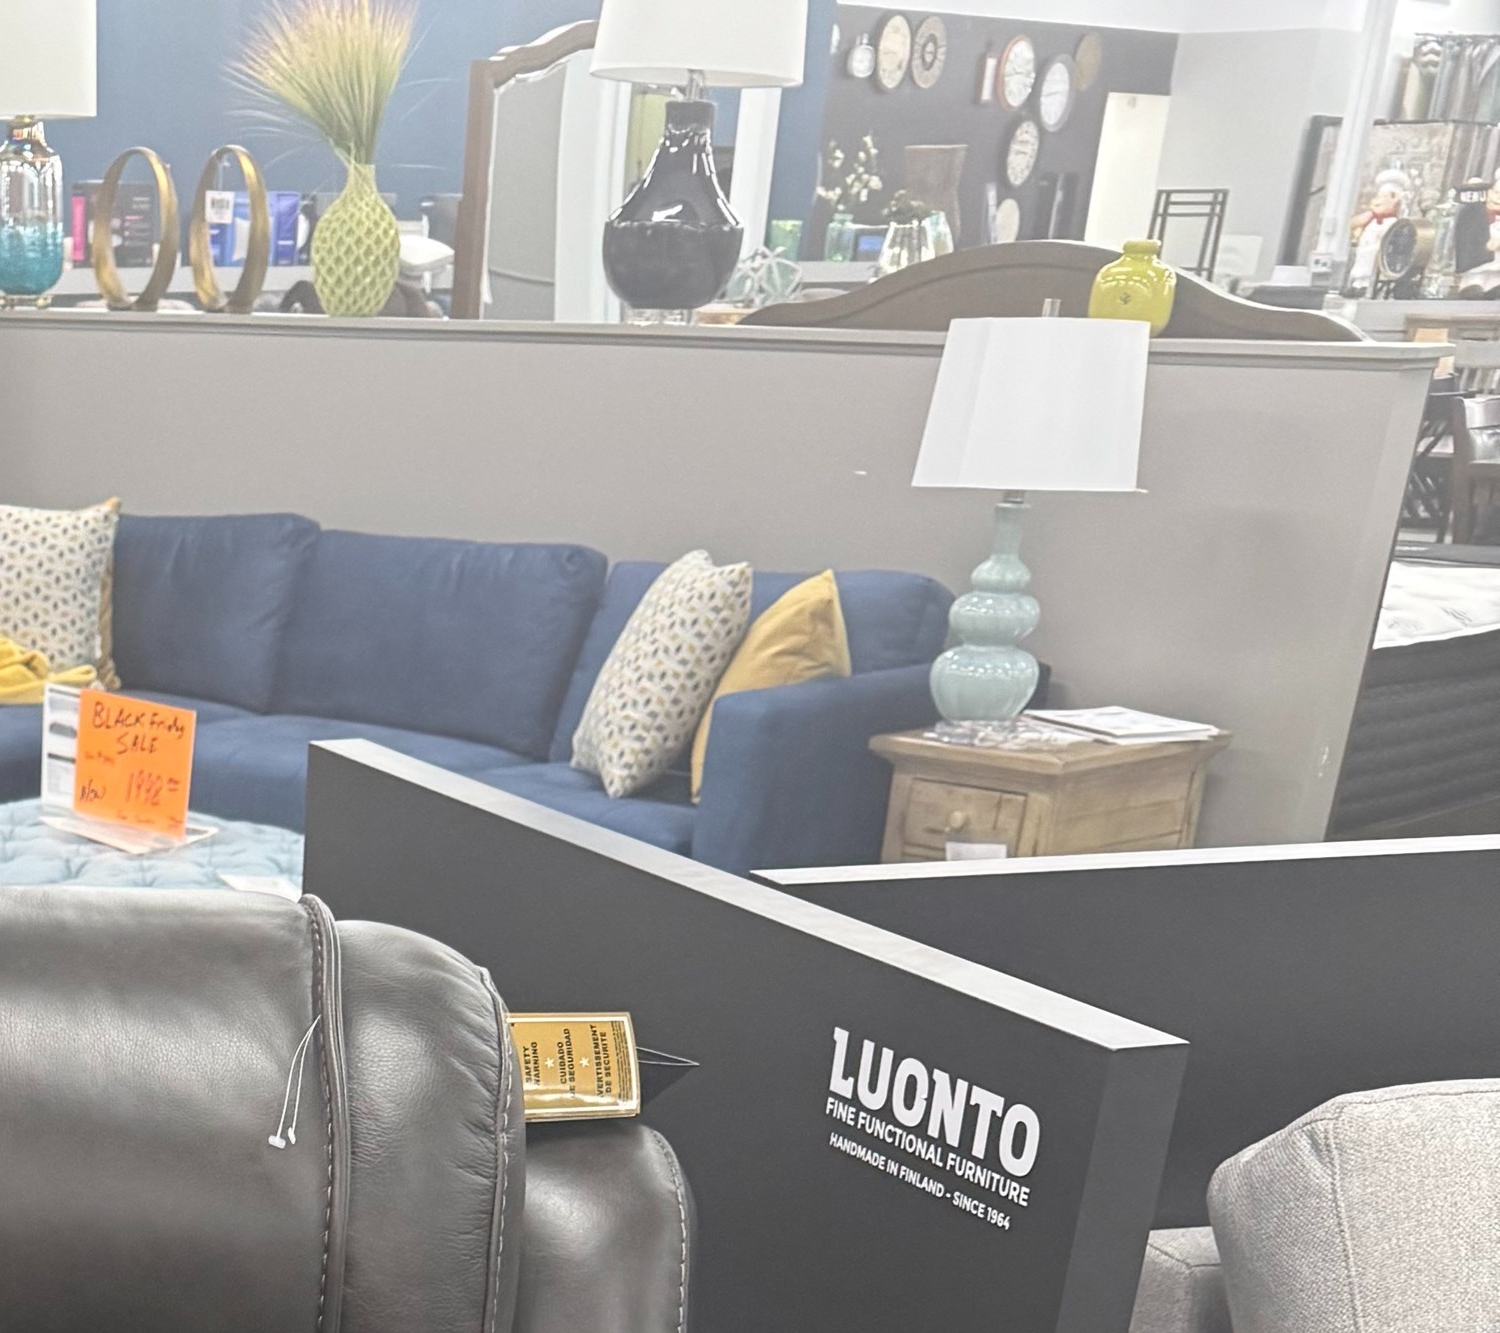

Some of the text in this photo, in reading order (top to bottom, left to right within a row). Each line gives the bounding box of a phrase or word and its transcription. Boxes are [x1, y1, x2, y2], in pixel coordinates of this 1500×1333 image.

[92, 701, 146, 730] BLACK
[116, 732, 159, 755] SALE
[523, 1046, 531, 1083] SAFETY
[557, 1042, 567, 1084] CUIDADO
[589, 1024, 605, 1097] VERTISSEMENT
[604, 1082, 612, 1094] DE
[829, 1027, 1041, 1177] LUONTO
[825, 1096, 1031, 1207] FINE FUNCTIONAL FURNITURE
[829, 1132, 886, 1170] HANDMADE
[886, 1159, 899, 1177] IN
[899, 1166, 945, 1198] FINLAND
[952, 1191, 985, 1218] SINCE
[986, 1207, 1011, 1230] 1964
